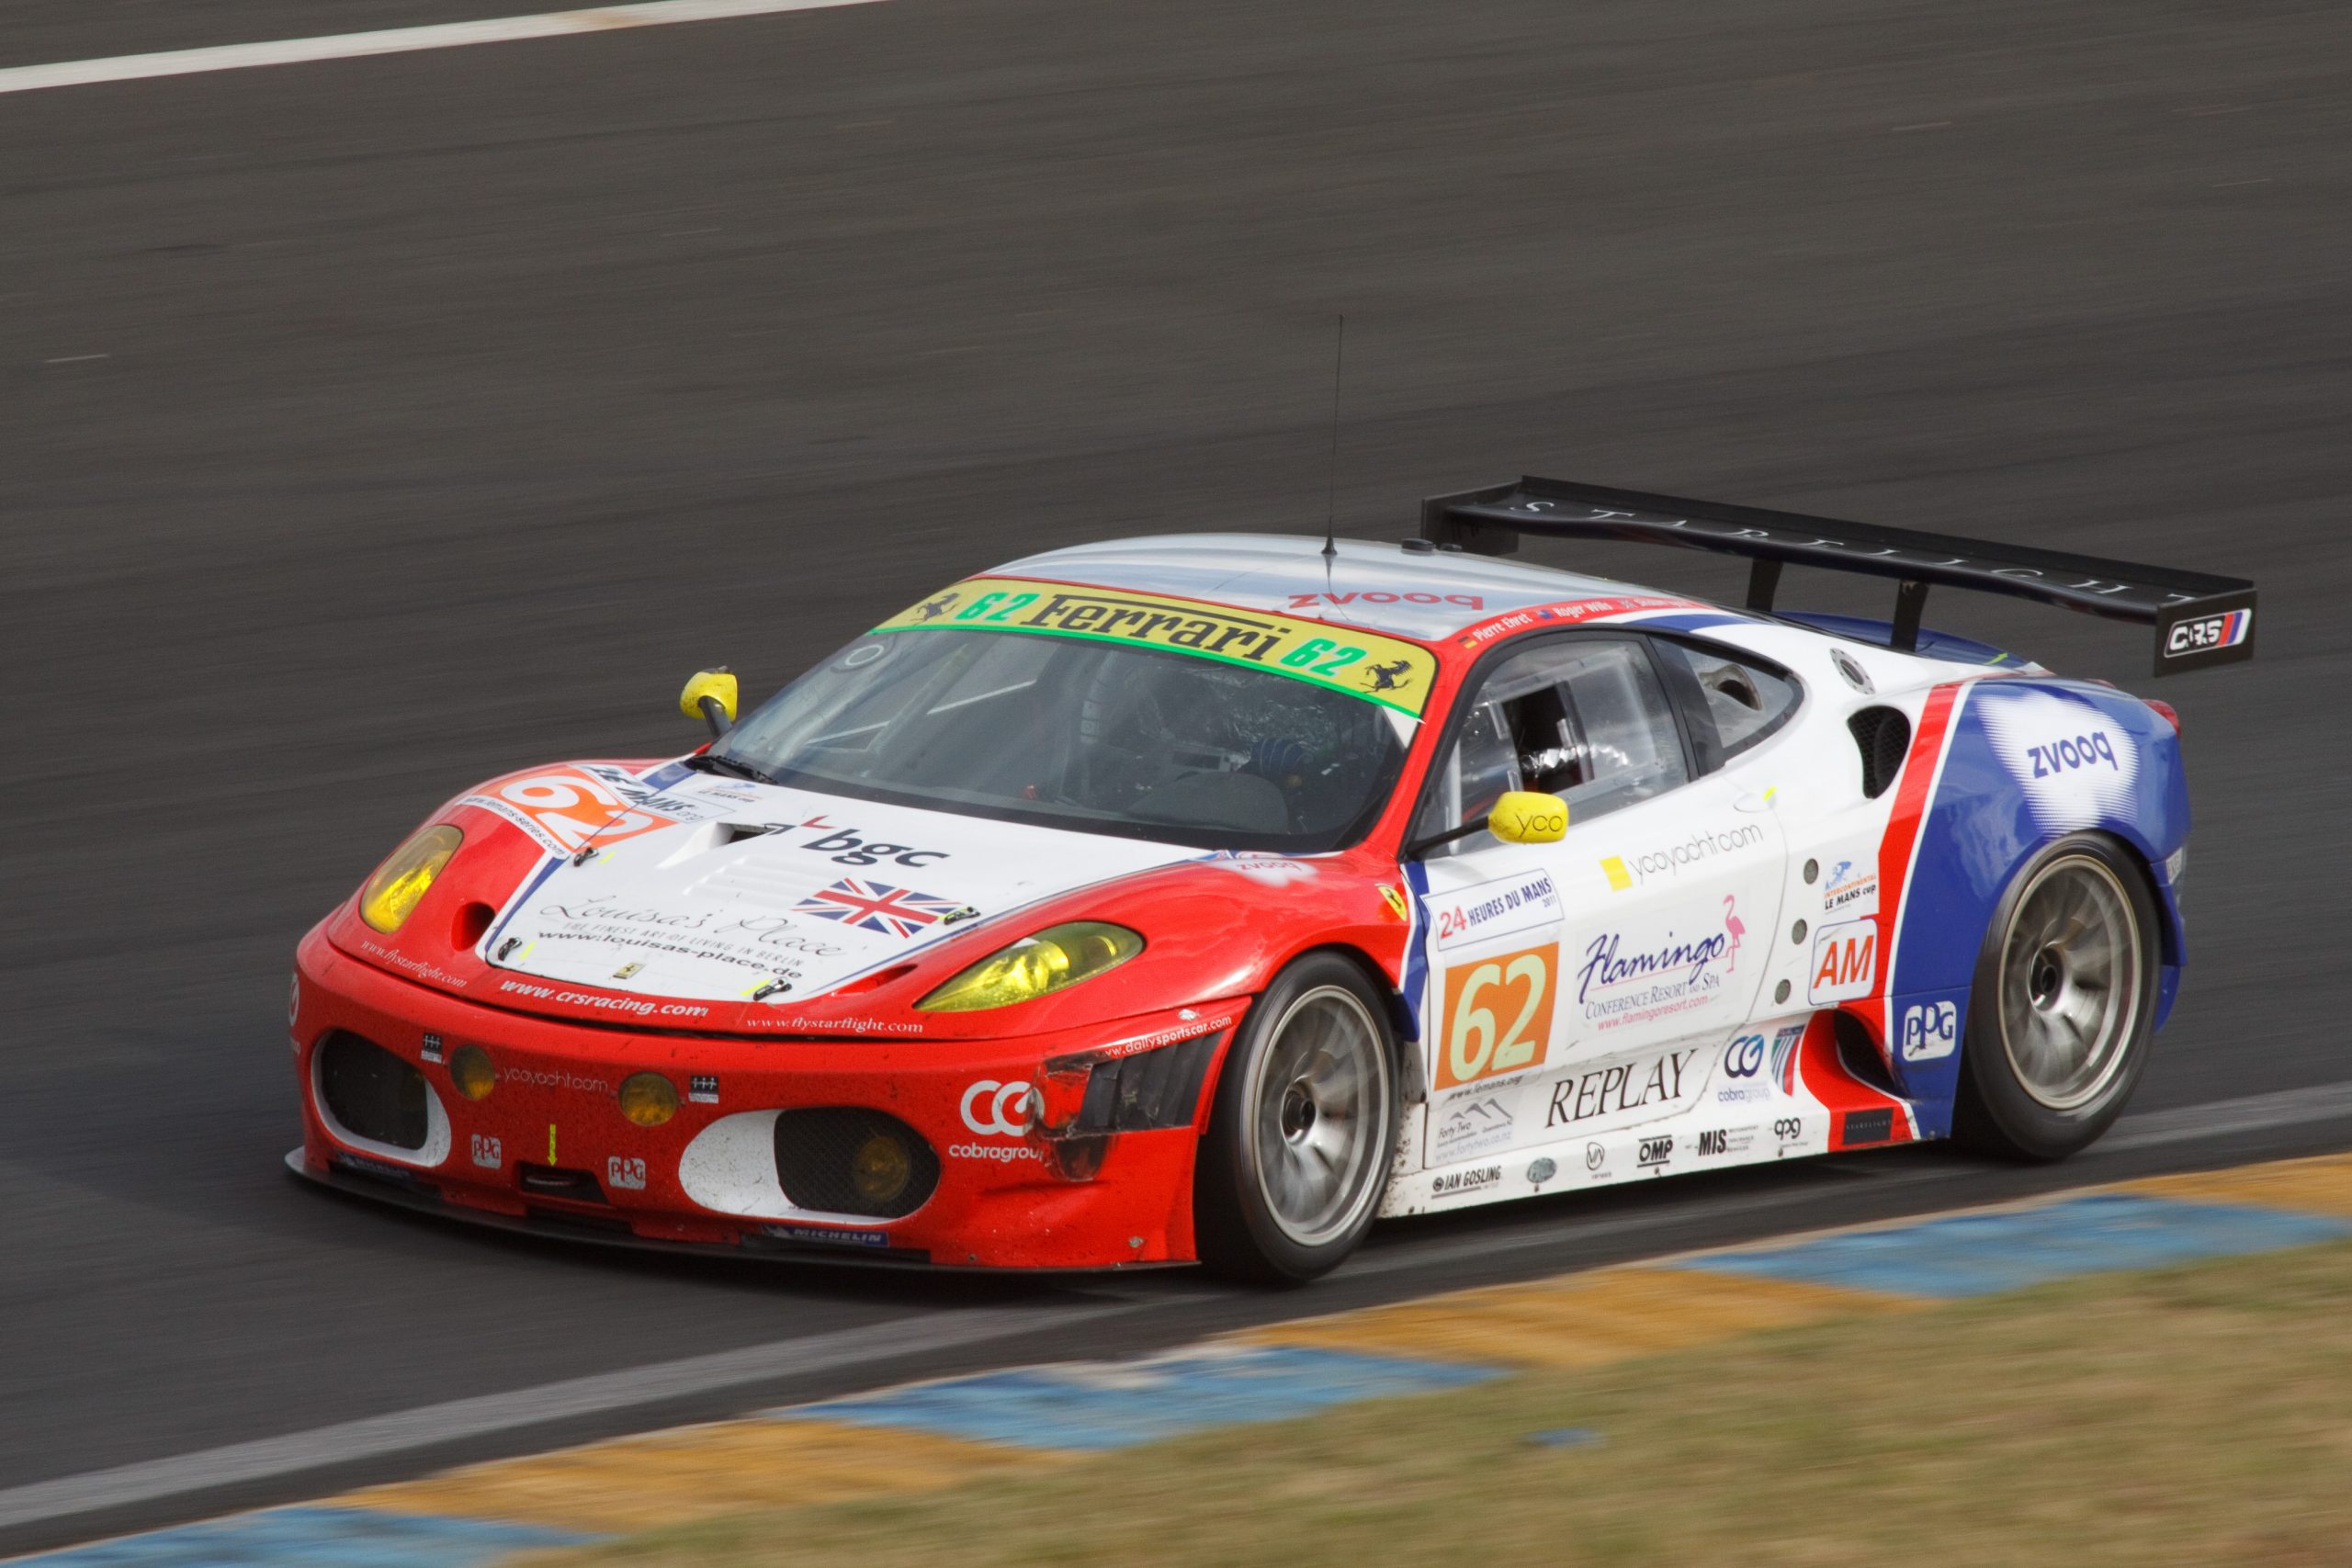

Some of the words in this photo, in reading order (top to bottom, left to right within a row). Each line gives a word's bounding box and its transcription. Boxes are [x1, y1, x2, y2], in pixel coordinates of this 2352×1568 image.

[1288, 592, 1485, 611] zvooq
[1555, 603, 1584, 619] Roger
[1584, 600, 1614, 613] Wills
[954, 592, 1041, 622] 62
[1019, 593, 1293, 662] Ferrari
[1278, 637, 1368, 679] 62
[1472, 622, 1506, 642] Pierre
[1504, 613, 1533, 630] Ehret
[2169, 619, 2223, 651] CRS
[2027, 730, 2119, 780] zvooq
[500, 775, 654, 851] 62
[1513, 812, 1564, 839] yco
[799, 829, 951, 868] bgc
[1440, 906, 1467, 940] 24
[1467, 897, 1505, 927] HEURES
[1506, 890, 1521, 910] DU
[1521, 877, 1553, 903] MANS
[1825, 898, 1834, 910] LE
[1837, 887, 1860, 906] MANS
[713, 915, 848, 957] Place
[360, 940, 468, 988] www.flystarflight.com
[1577, 931, 1725, 1005] Flamingo
[1812, 934, 1875, 990] AM
[500, 977, 709, 1017] www.crsracing.com
[1585, 991, 1650, 1021] CONFERENCE
[1650, 982, 1689, 1004] RESORT
[1702, 972, 1721, 991] SPA
[1598, 995, 1709, 1031] www.flamingoresort.com
[746, 1017, 924, 1033] www.flystarflight.com
[1449, 953, 1547, 1082] 62
[503, 1066, 608, 1092] ycoyacht.com
[1544, 1049, 1699, 1129] REPLAY
[1717, 1086, 1770, 1105] cobragroup
[1639, 1139, 1673, 1163] OMP
[1699, 1129, 1727, 1156] MIS
[1444, 1172, 1462, 1190] IAN
[1464, 1165, 1502, 1187] GOSLING
[793, 1228, 882, 1243] MICHELIN
